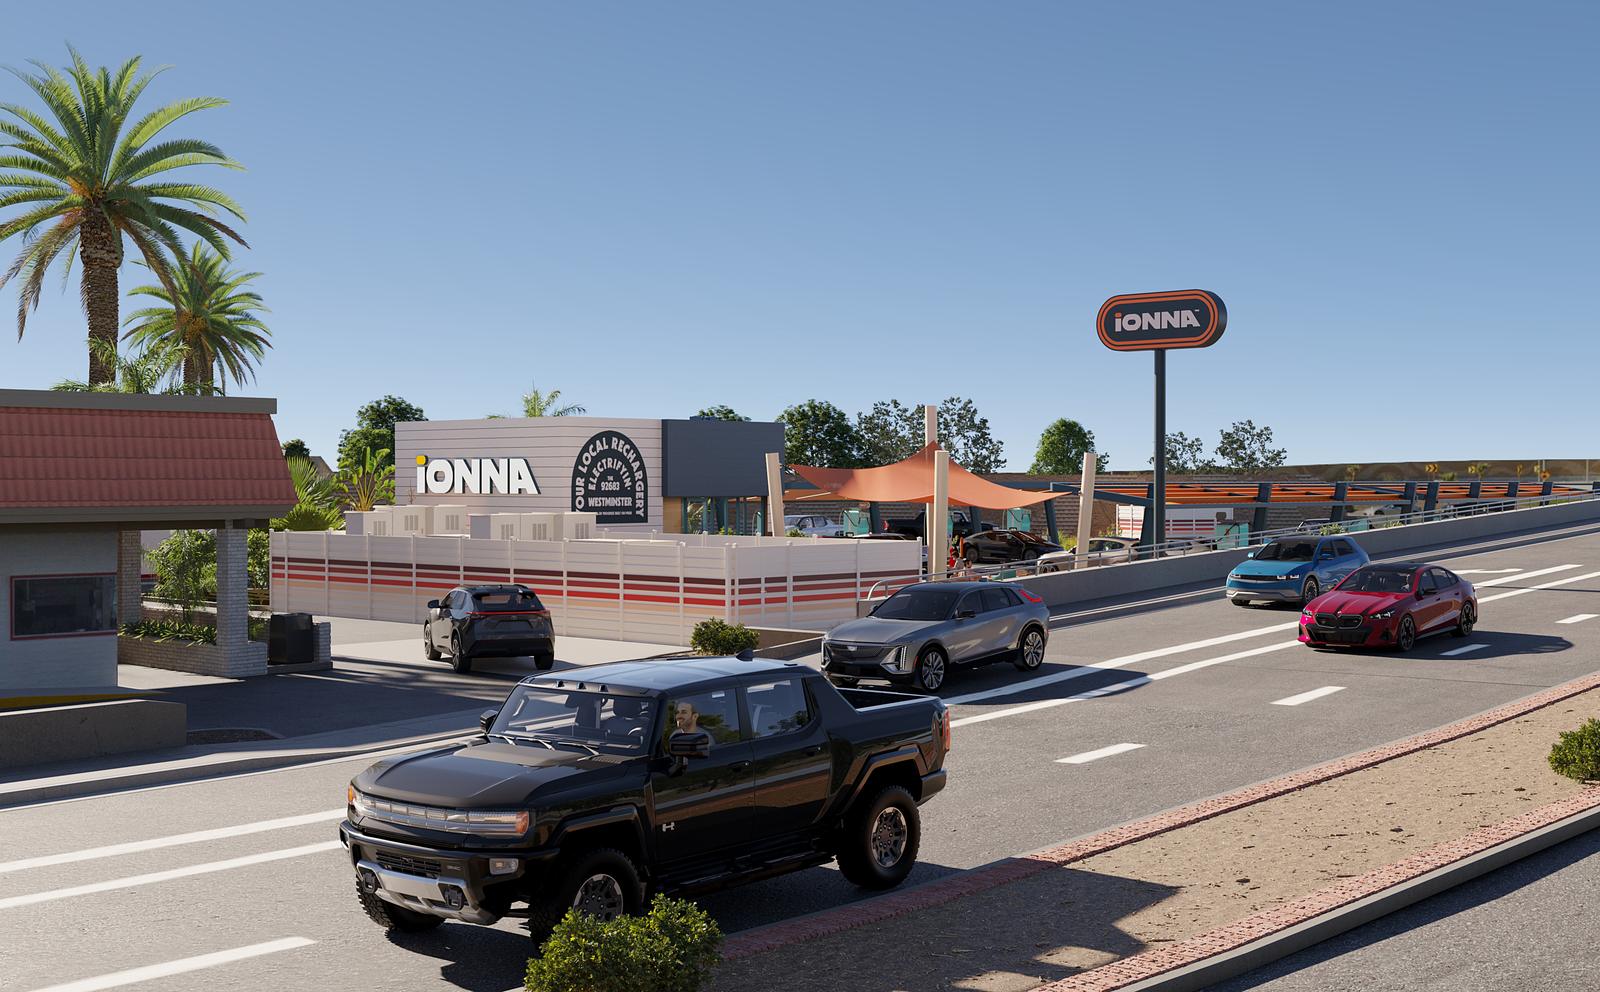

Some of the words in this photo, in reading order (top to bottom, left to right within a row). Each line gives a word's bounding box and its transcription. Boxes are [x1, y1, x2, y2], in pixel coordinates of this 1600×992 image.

[578, 437, 609, 474] LOCAL
[575, 477, 585, 512] OUR
[600, 481, 620, 491] 92683
[611, 436, 645, 518] RECHARGERY
[588, 496, 633, 507] WESTMINSTER
